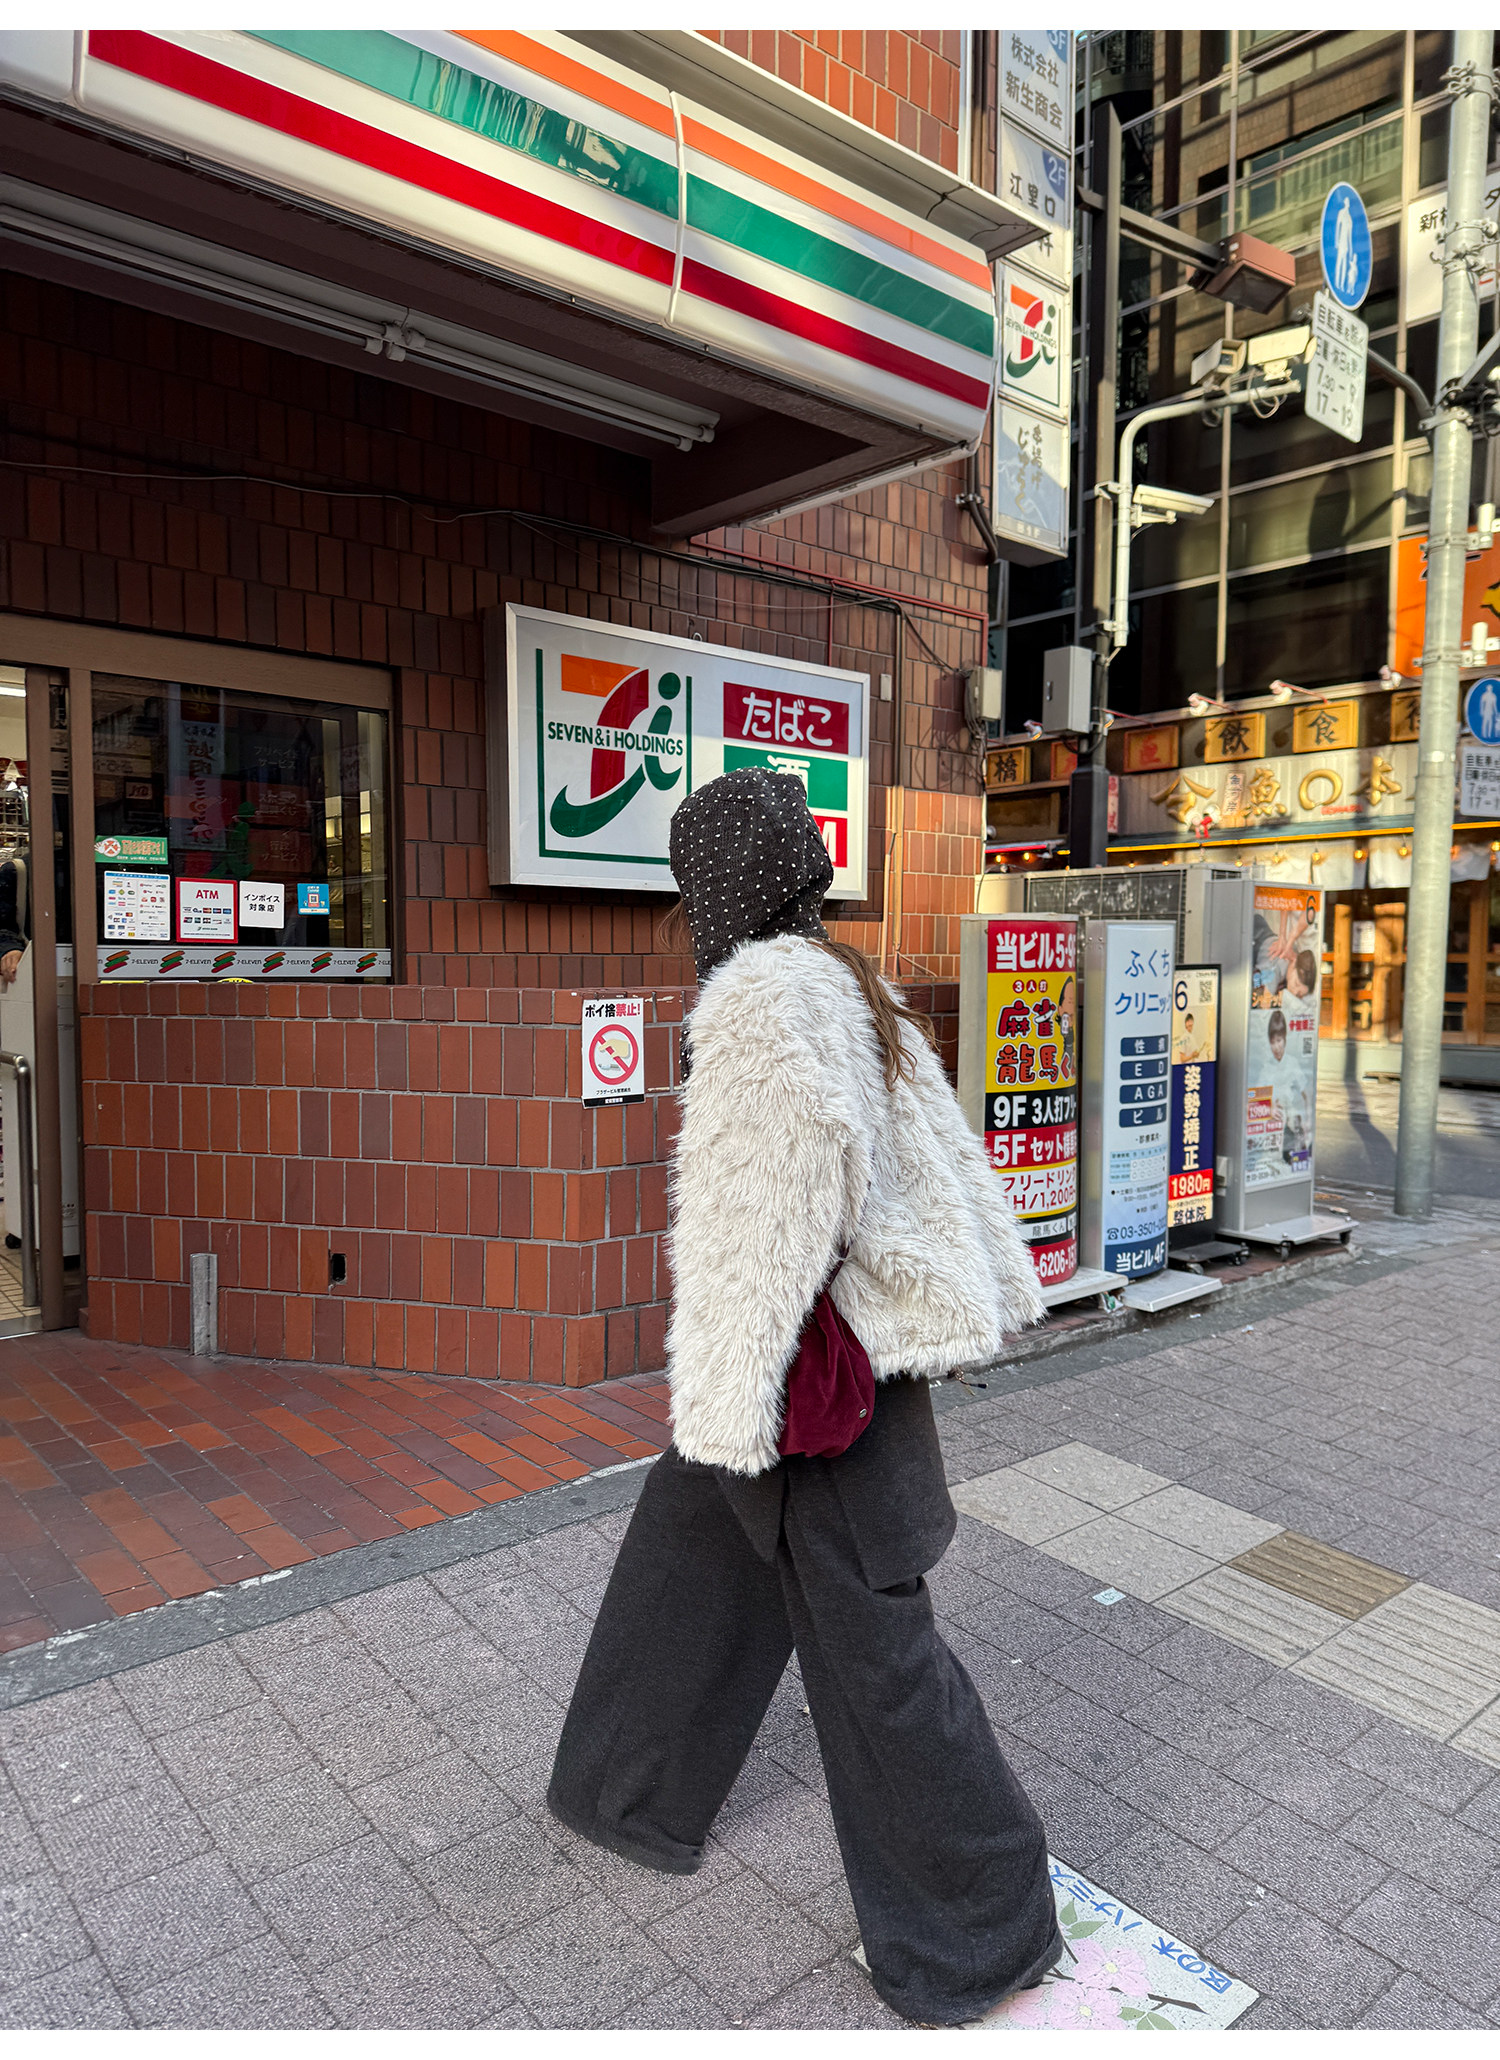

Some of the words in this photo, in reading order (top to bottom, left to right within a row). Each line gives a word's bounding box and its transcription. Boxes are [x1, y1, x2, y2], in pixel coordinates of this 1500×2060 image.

[1010, 33, 1059, 88] 株式会社
[1006, 70, 1063, 131] 新生商会
[1048, 156, 1066, 187] 2F
[1010, 172, 1056, 218] 江里口
[742, 692, 833, 748] たばこ
[614, 733, 684, 756] HOLDINGS
[994, 752, 1018, 783] 橋
[195, 889, 219, 900] ATM
[243, 894, 280, 903] インボイス
[249, 903, 275, 913] 対象店
[1305, 895, 1317, 926] 6
[1124, 950, 1170, 978] ふくち
[1012, 979, 1049, 993] 3人打
[1174, 980, 1188, 1012] 6
[996, 997, 1057, 1039] 麻雀
[1134, 1084, 1164, 1101] AGA
[993, 1095, 1028, 1129] 9F
[1182, 1064, 1202, 1171] 姿勢矯正
[994, 1133, 1027, 1168] 5F
[1171, 1173, 1211, 1198] 1980円
[1173, 1205, 1207, 1226] 整体院
[1116, 1241, 1165, 1273] 当ビル4F
